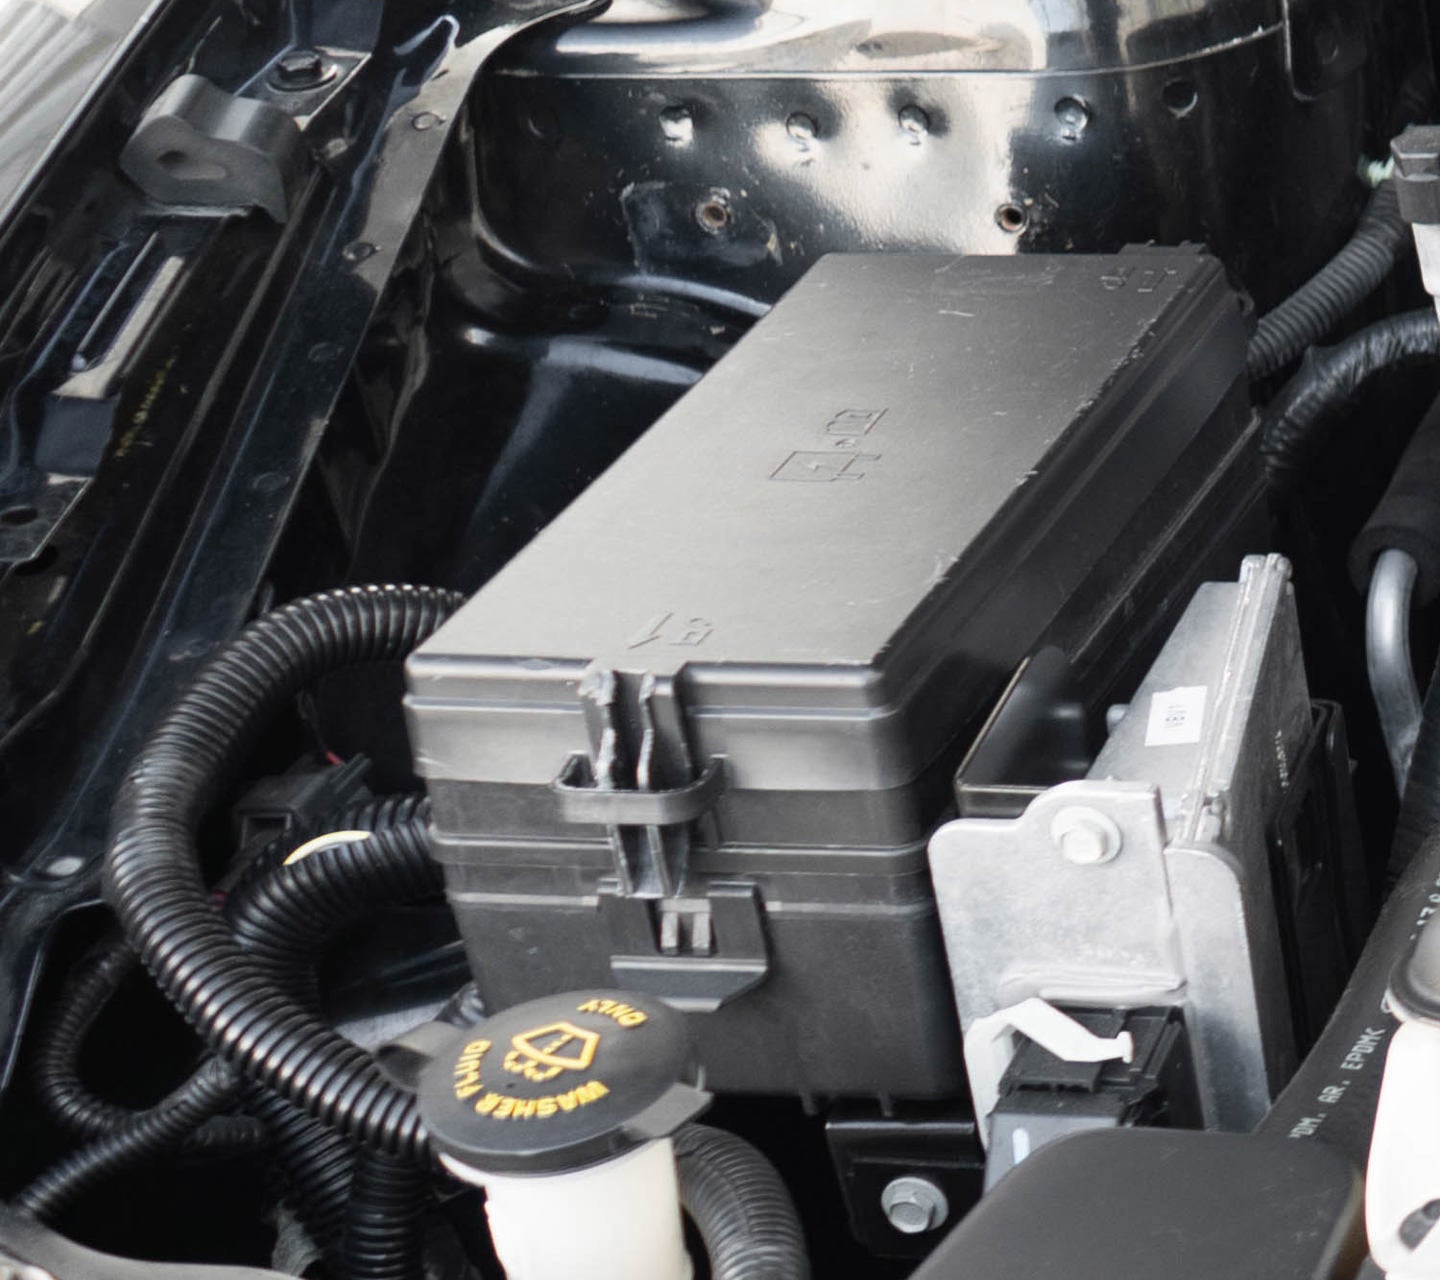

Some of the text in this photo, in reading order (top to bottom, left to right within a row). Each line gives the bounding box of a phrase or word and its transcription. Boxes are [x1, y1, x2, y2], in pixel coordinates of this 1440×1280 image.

[575, 998, 648, 1029] ONLY
[452, 1039, 611, 1121] WASHER FLUID
